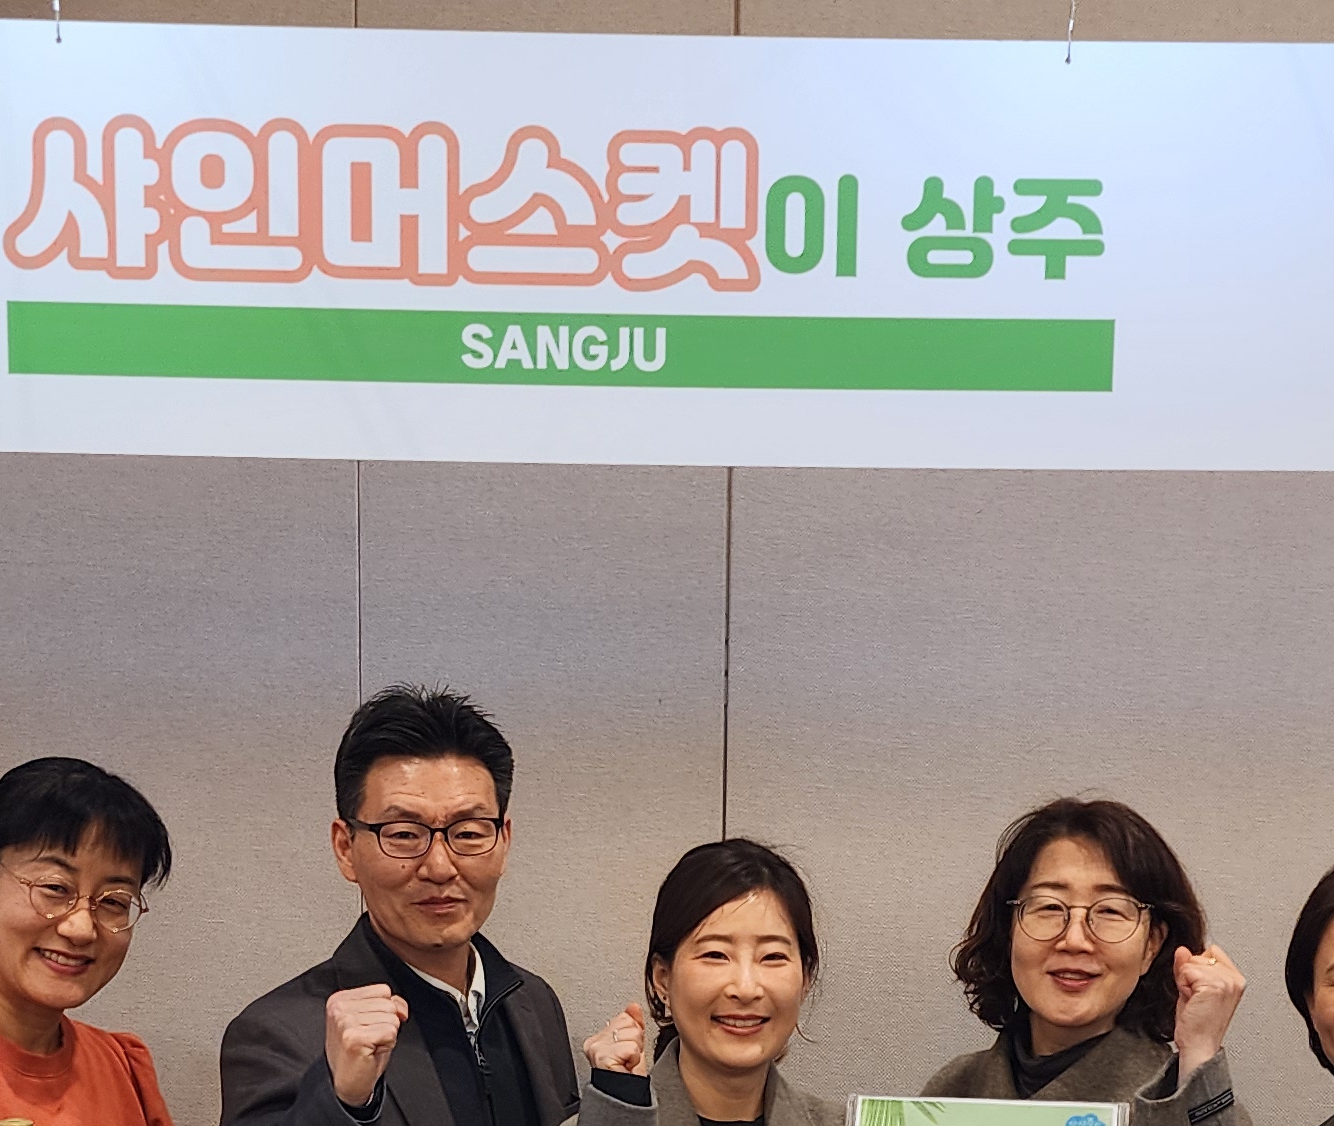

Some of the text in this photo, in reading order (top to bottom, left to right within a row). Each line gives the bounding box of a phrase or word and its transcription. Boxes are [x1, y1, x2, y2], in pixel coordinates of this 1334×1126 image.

[2, 114, 1105, 293] 샤인머스켓이 상주
[460, 323, 668, 373] SANGJU
